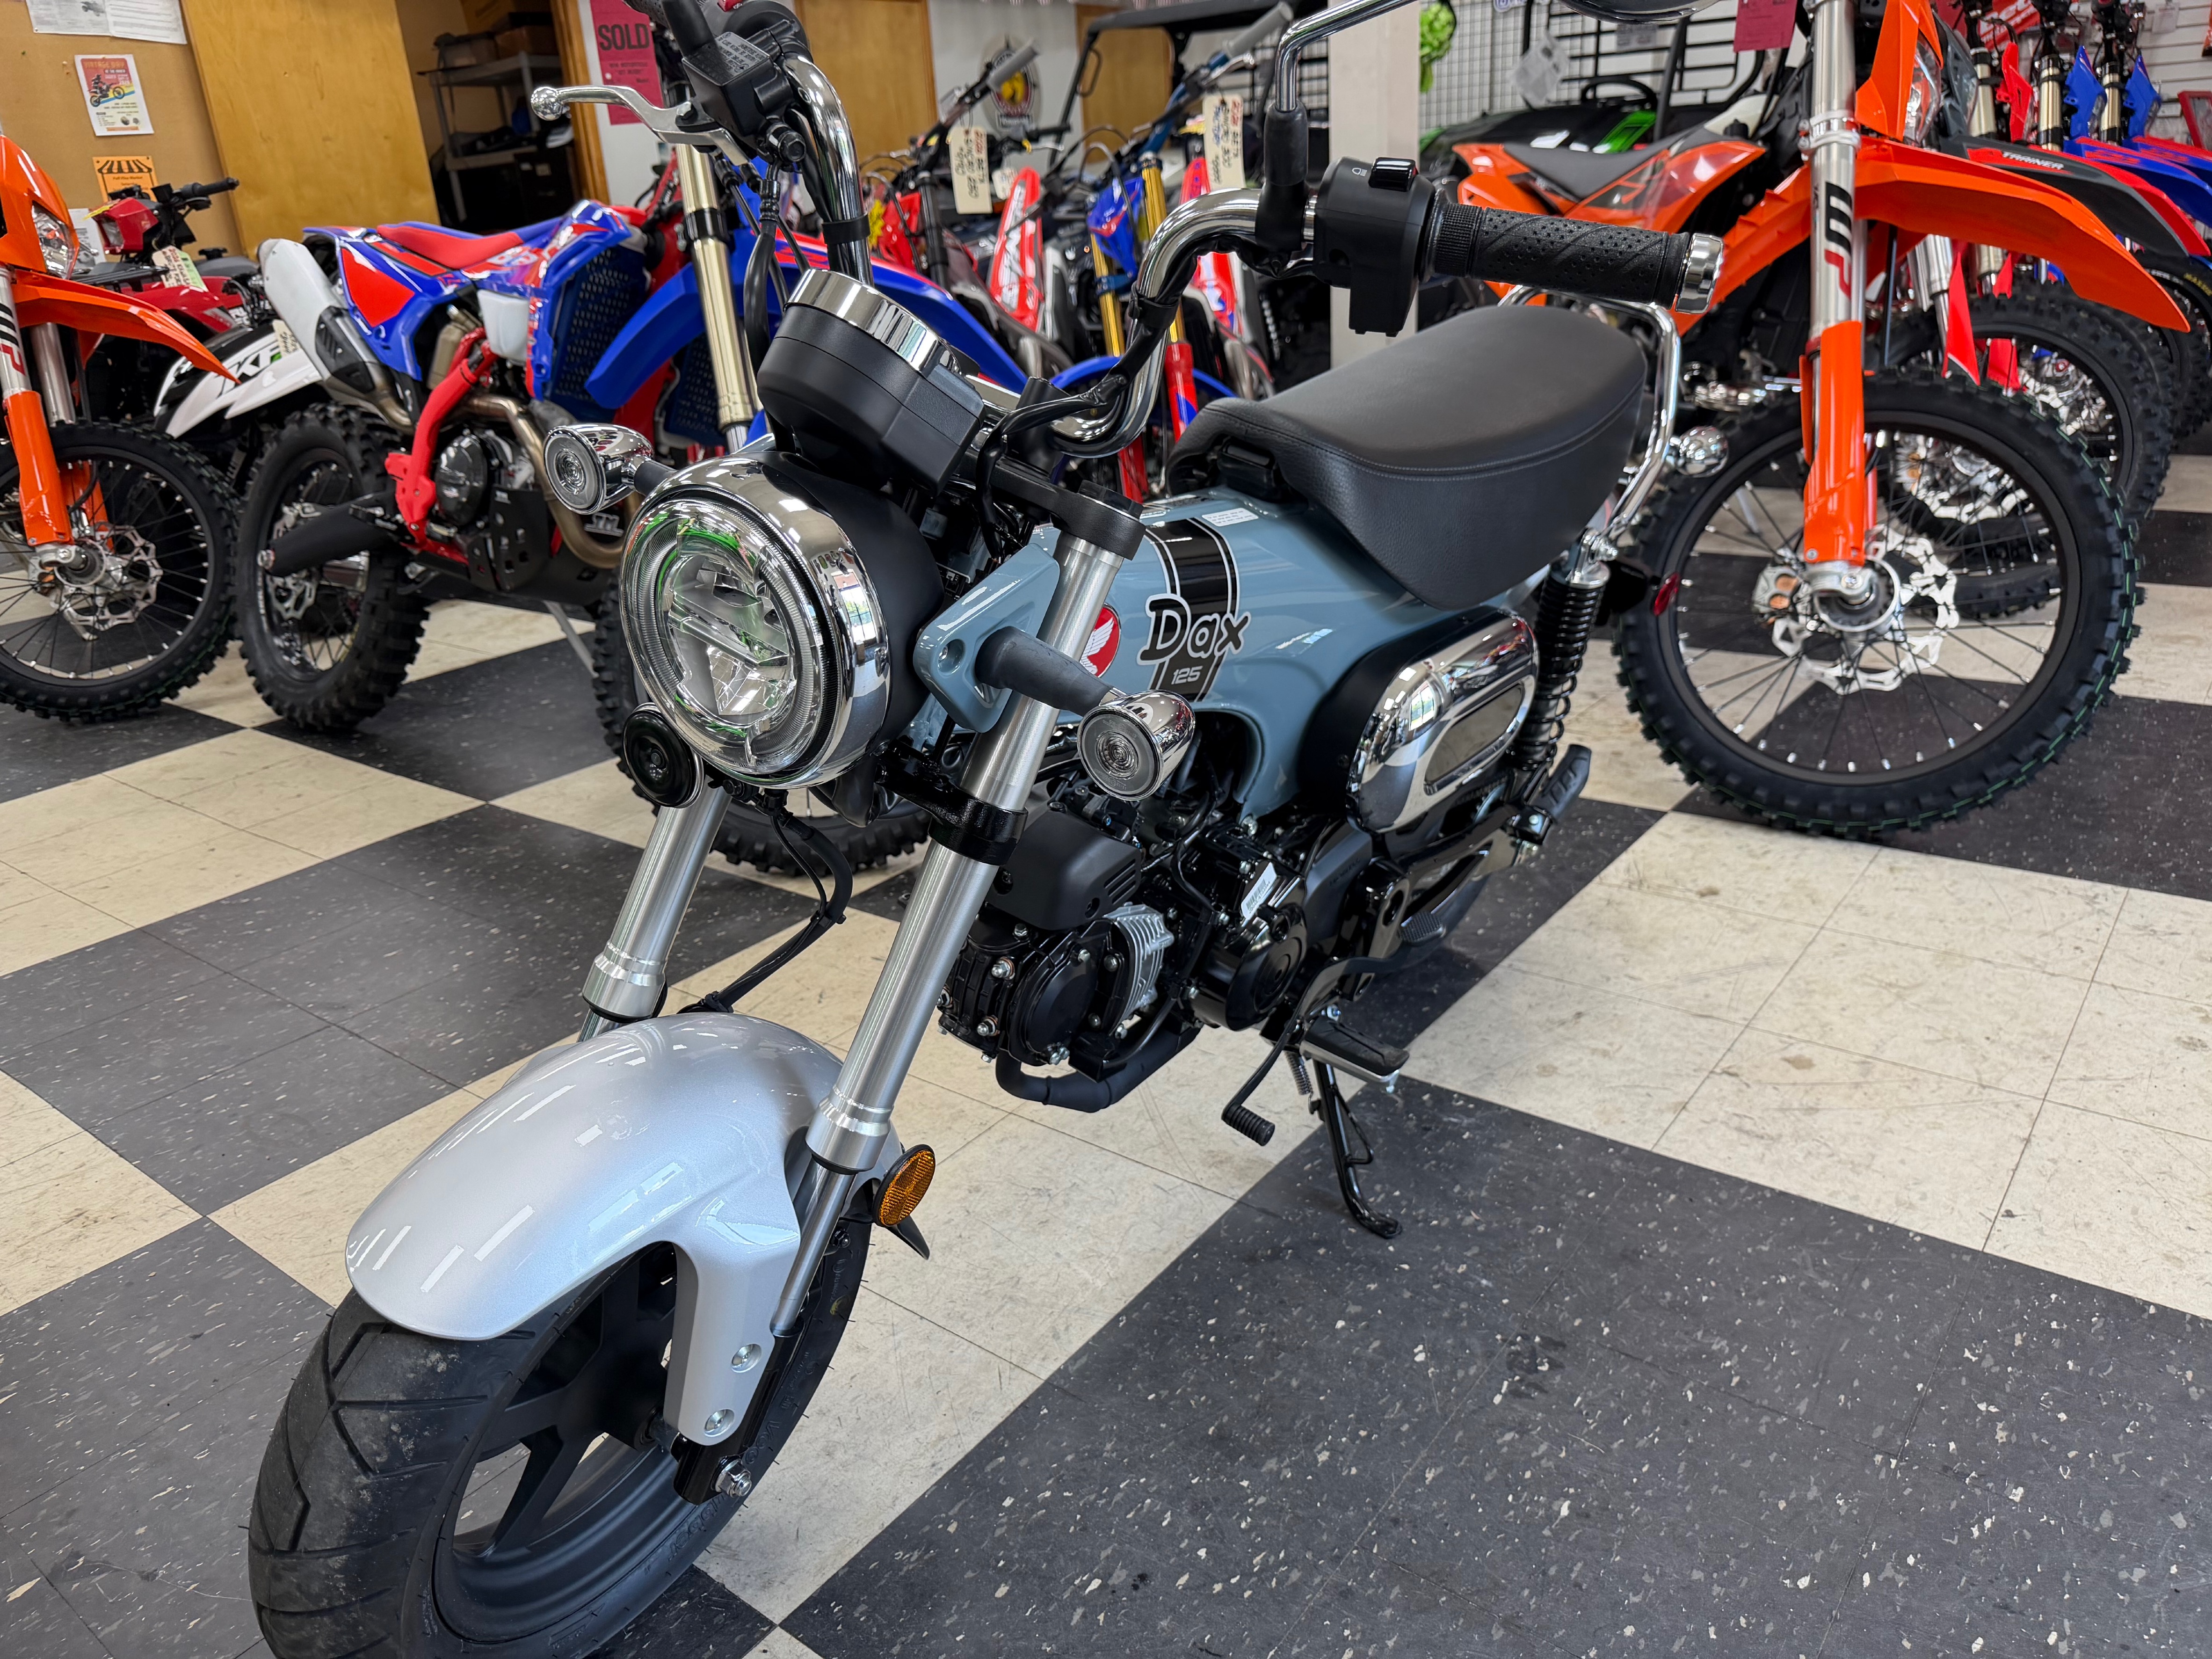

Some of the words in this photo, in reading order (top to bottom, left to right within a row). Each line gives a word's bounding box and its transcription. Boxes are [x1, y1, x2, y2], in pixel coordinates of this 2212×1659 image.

[598, 23, 649, 51] SOLD
[2002, 151, 2064, 170] TRAINER
[1825, 181, 1852, 301] WP
[1137, 593, 1251, 665] Dax
[1171, 665, 1204, 685] 125
